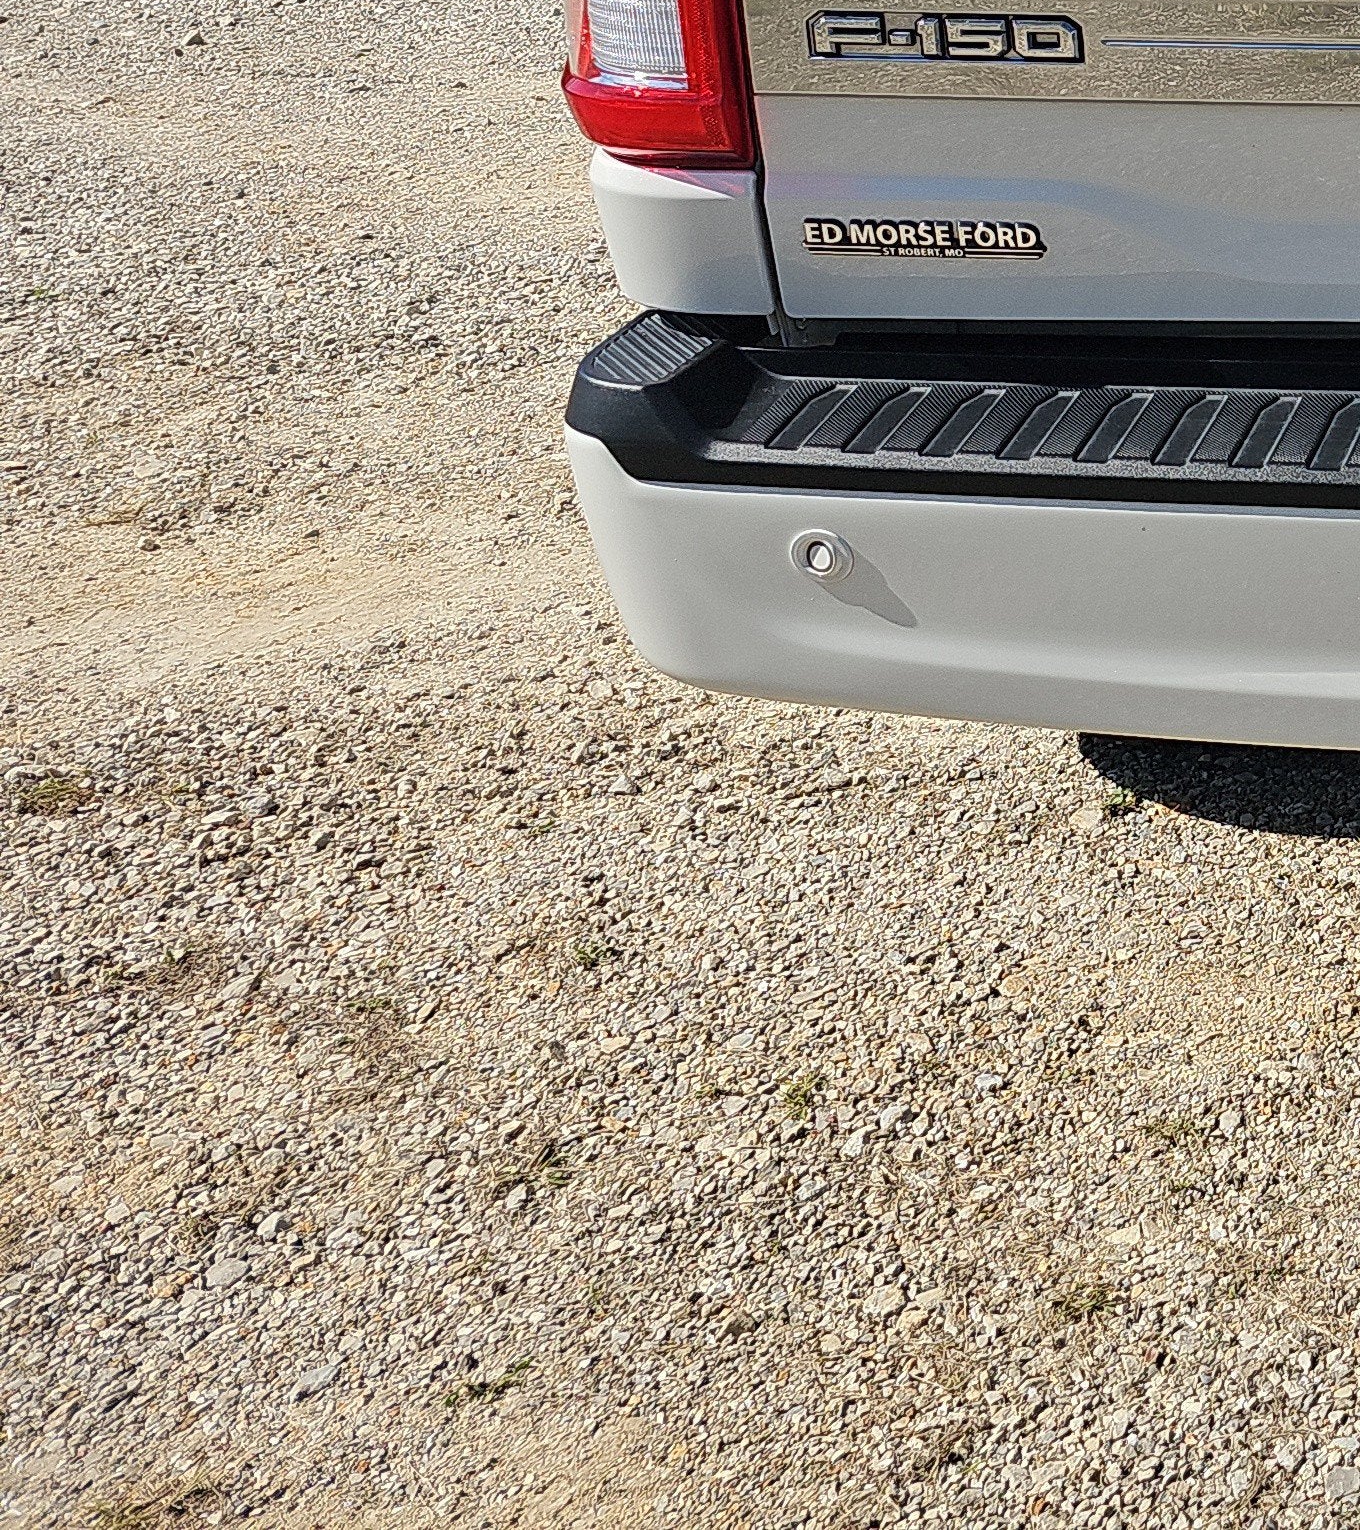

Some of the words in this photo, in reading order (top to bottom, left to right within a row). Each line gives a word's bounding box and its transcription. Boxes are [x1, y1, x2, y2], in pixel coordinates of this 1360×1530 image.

[806, 10, 1085, 64] F-150
[803, 221, 842, 245] ED
[850, 222, 951, 247] MORSE
[958, 224, 1037, 249] FORD
[945, 248, 964, 258] MO
